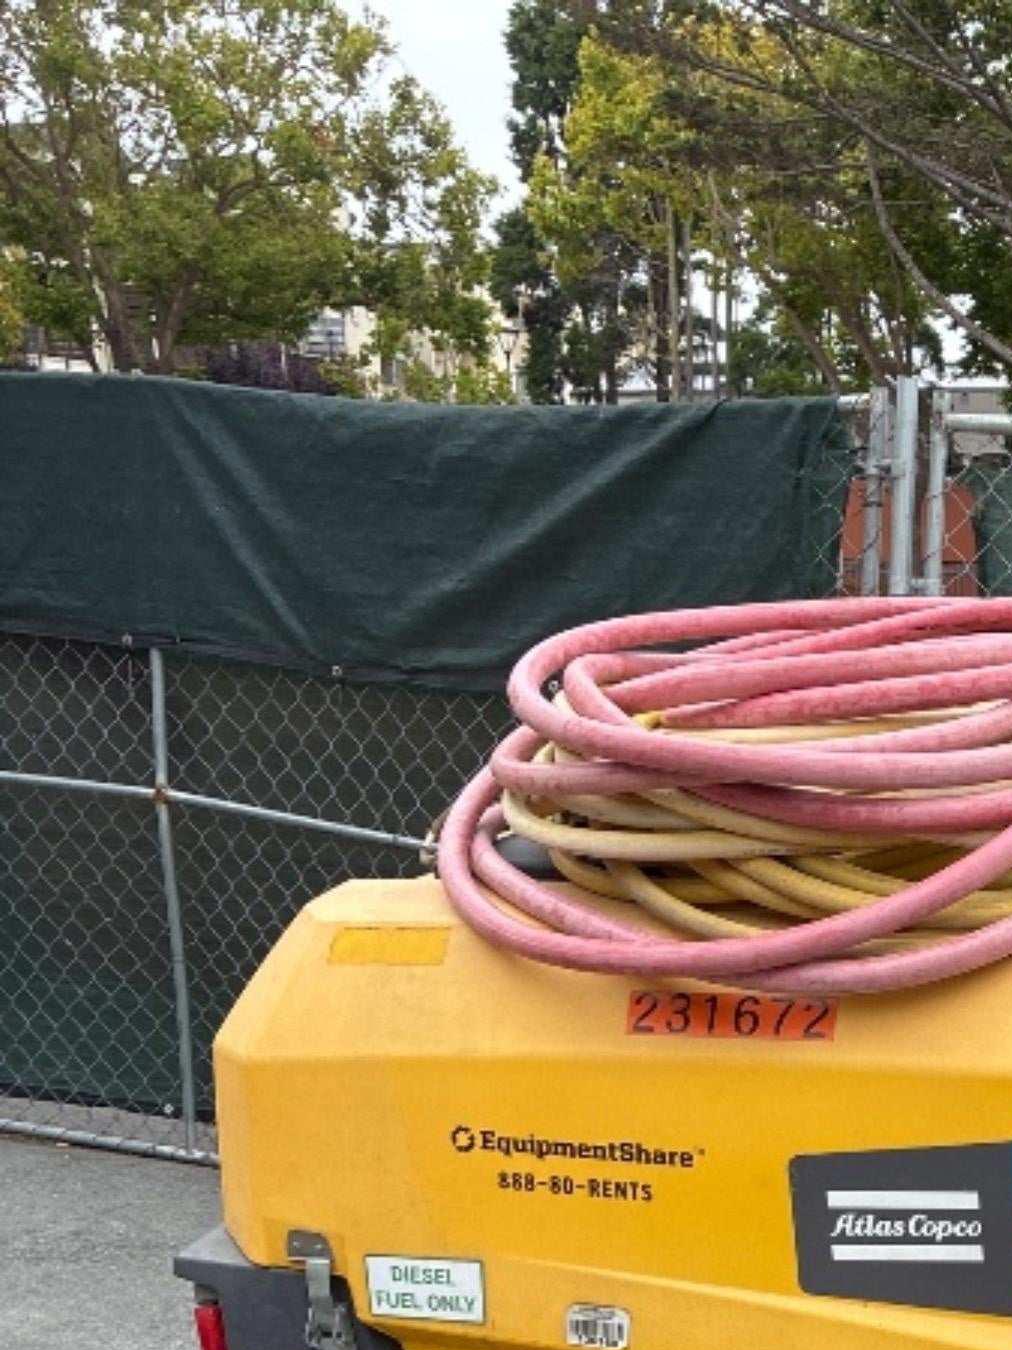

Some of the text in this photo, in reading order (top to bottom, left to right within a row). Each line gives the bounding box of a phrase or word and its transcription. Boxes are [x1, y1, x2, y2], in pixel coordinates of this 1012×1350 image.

[632, 991, 830, 1039] 231672
[479, 1130, 694, 1168] EquipmentShare
[830, 1213, 983, 1243] Atlas Copco
[391, 1265, 456, 1287] DIESEL
[375, 1289, 476, 1313] FUEL ONLY
